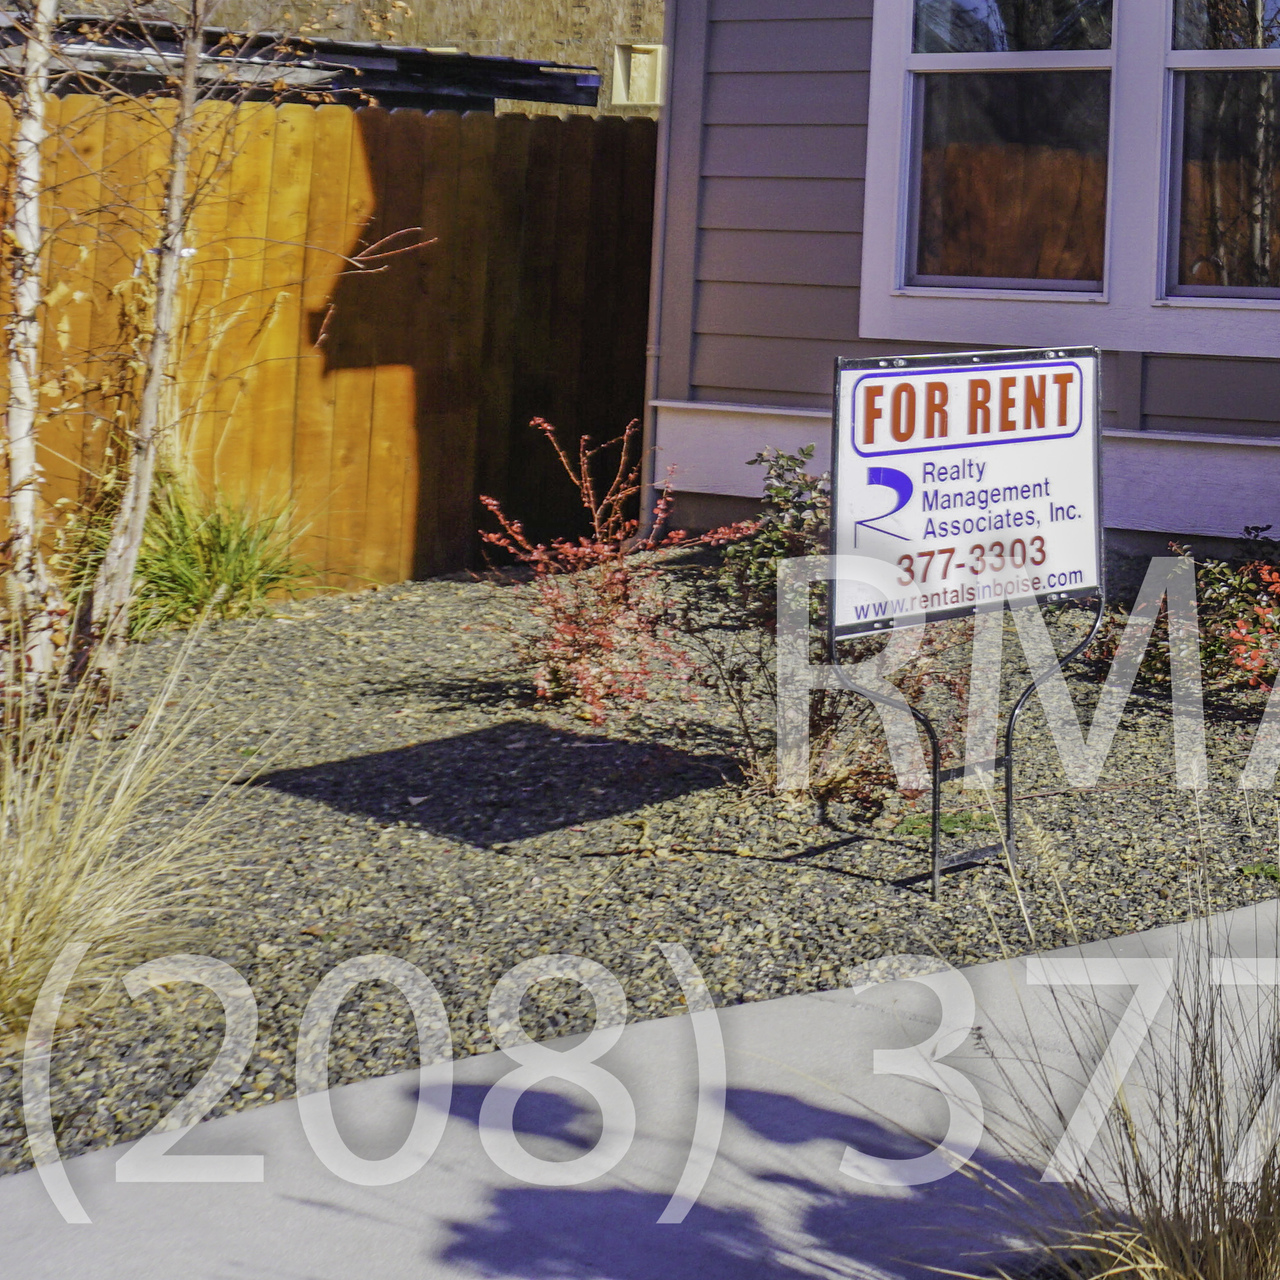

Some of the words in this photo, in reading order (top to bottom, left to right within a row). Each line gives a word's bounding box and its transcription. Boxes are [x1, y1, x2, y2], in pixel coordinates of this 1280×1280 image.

[862, 381, 949, 445] FOR
[966, 372, 1074, 435] RENT
[922, 458, 986, 484] Realty
[922, 477, 1051, 512] Management
[923, 510, 1041, 540] Associates,
[1049, 501, 1082, 523] Inc.
[896, 535, 1047, 587] 377-3303
[854, 568, 1084, 620] www.rentalsinboise.com
